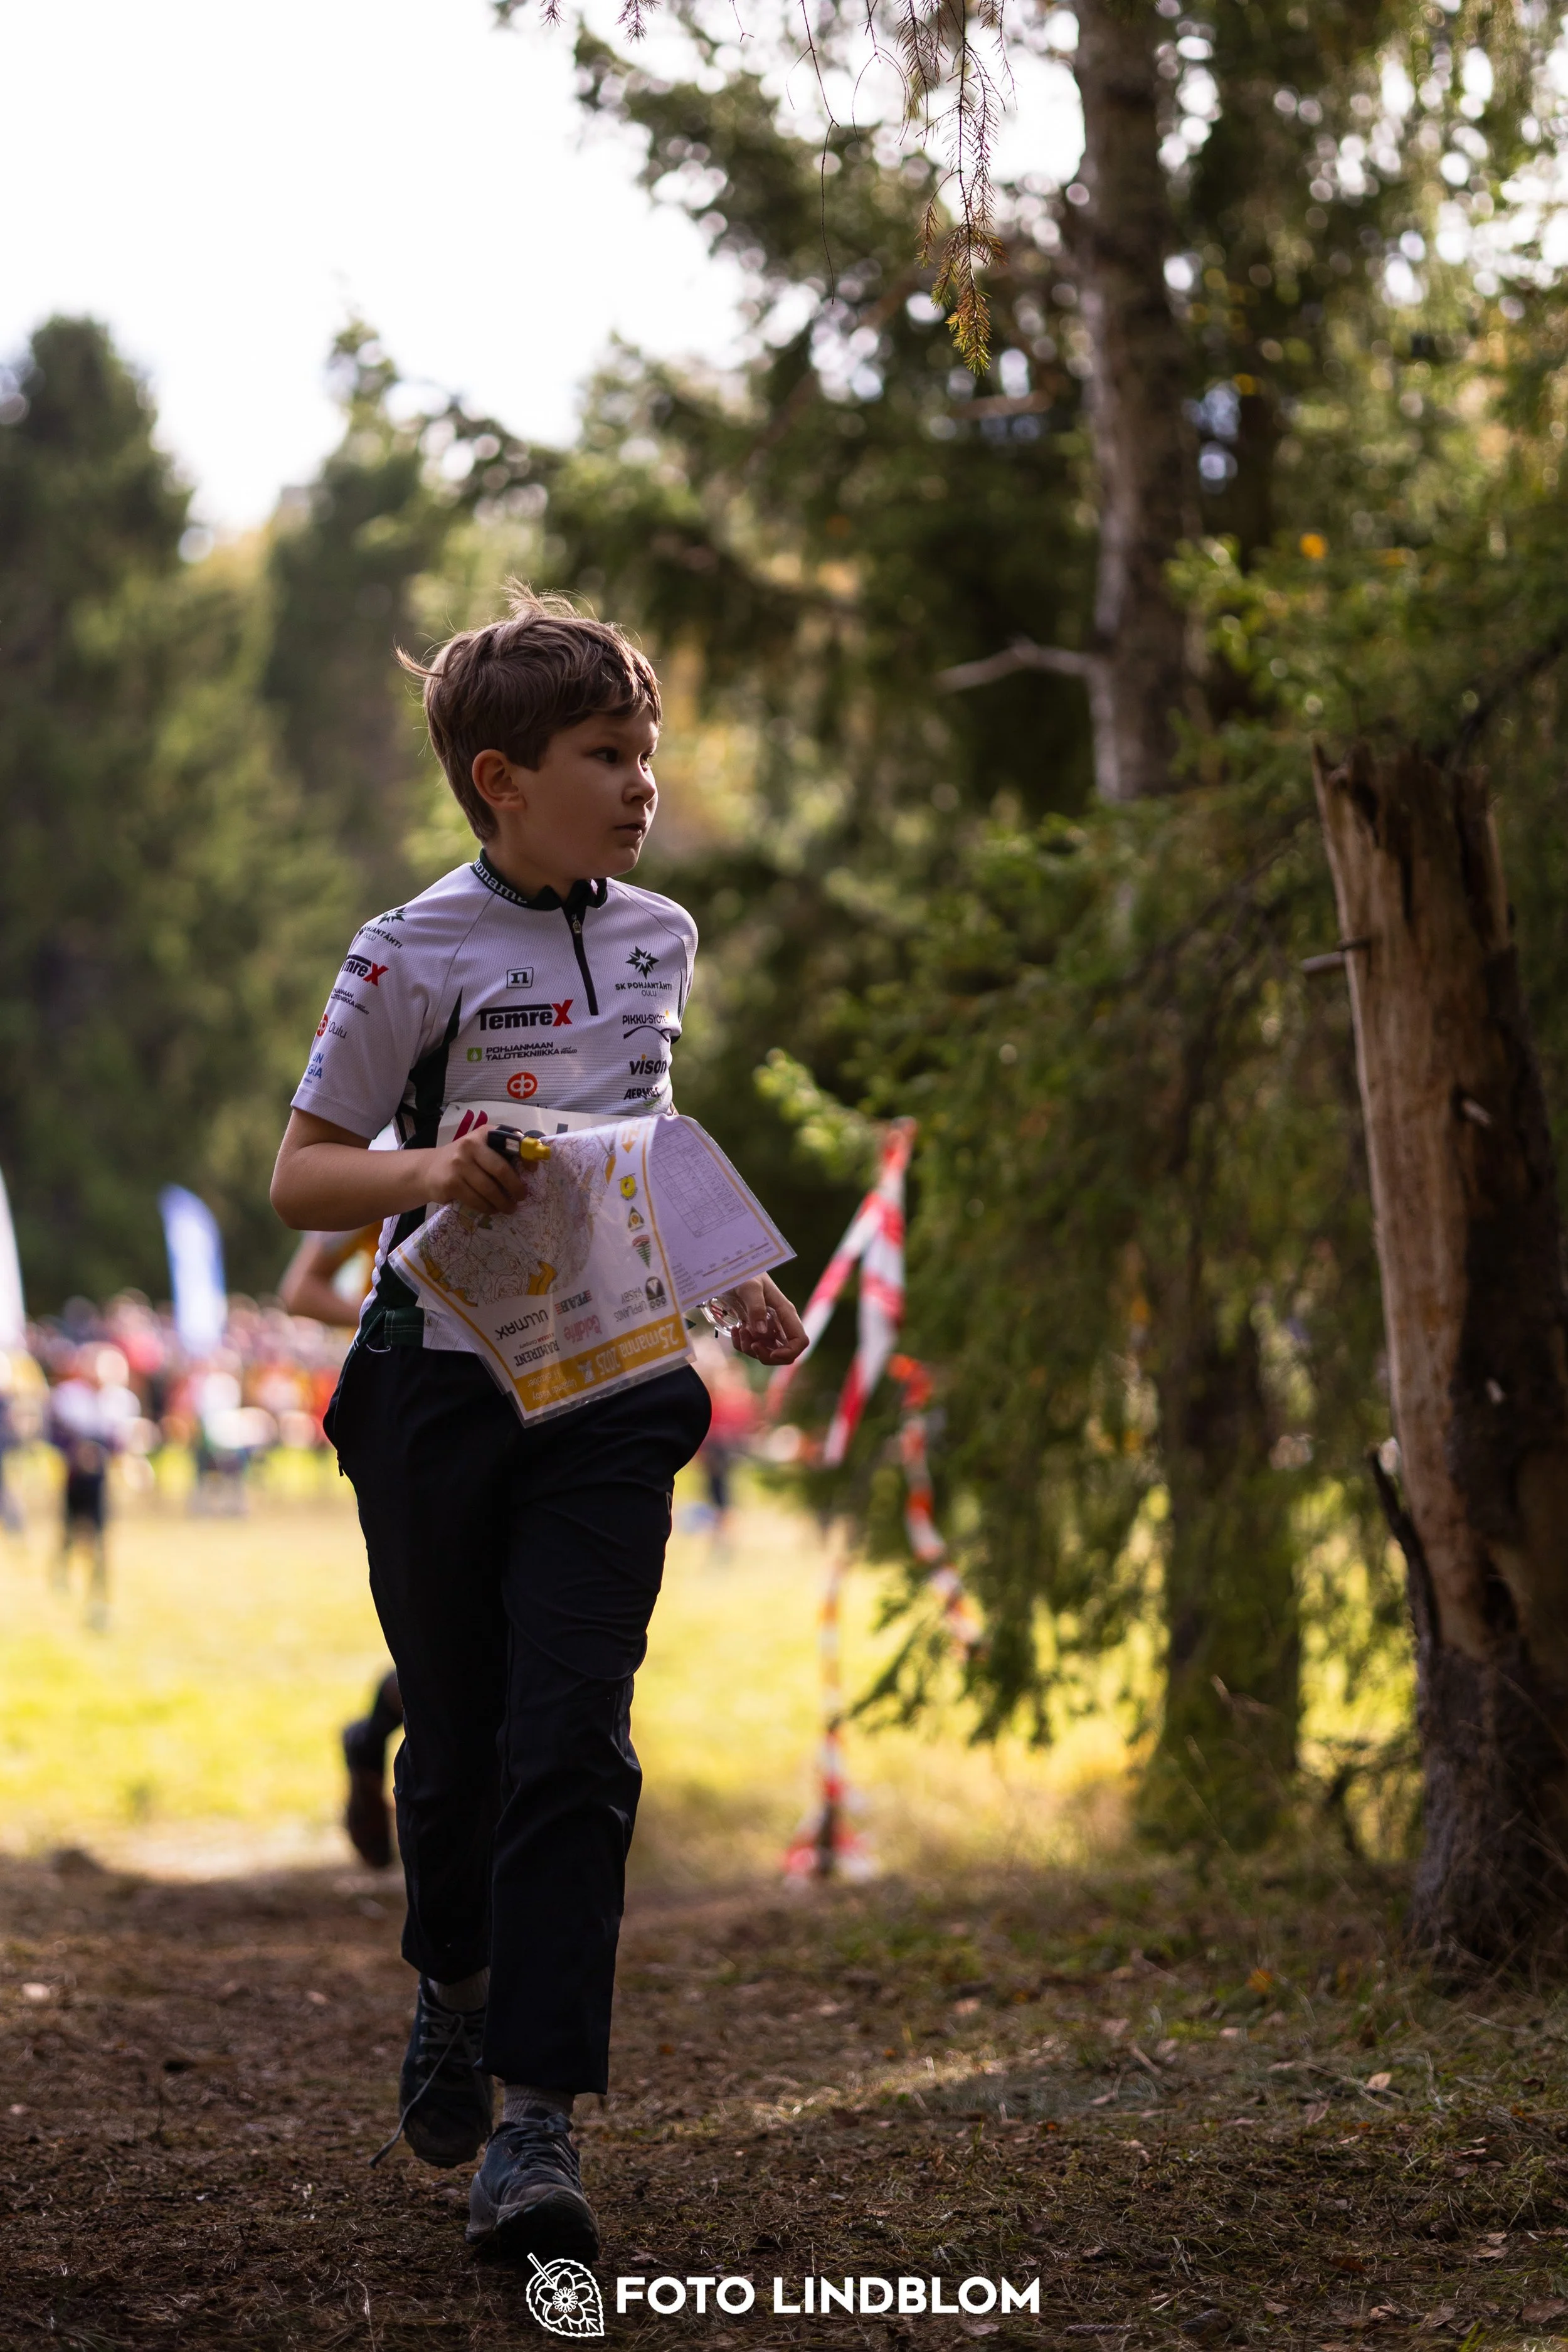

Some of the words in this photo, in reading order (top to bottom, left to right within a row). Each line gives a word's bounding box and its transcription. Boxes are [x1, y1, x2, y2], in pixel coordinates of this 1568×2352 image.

[627, 981, 672, 991] POHJANTÄHTI
[328, 1021, 347, 1039] Oulu
[485, 1048, 560, 1061] TALOTEKNIIKKA
[486, 1042, 554, 1054] POHJANMAAN
[560, 1291, 590, 1314] PEAB
[613, 1300, 647, 1322] UPPLANDS
[495, 1309, 549, 1340] ULLMAX
[519, 1339, 538, 1349] Company
[620, 1322, 679, 1359] 25manna
[514, 1340, 560, 1367] RAMIRENT
[595, 1348, 622, 1375] 2025
[527, 1372, 552, 1387] oktober
